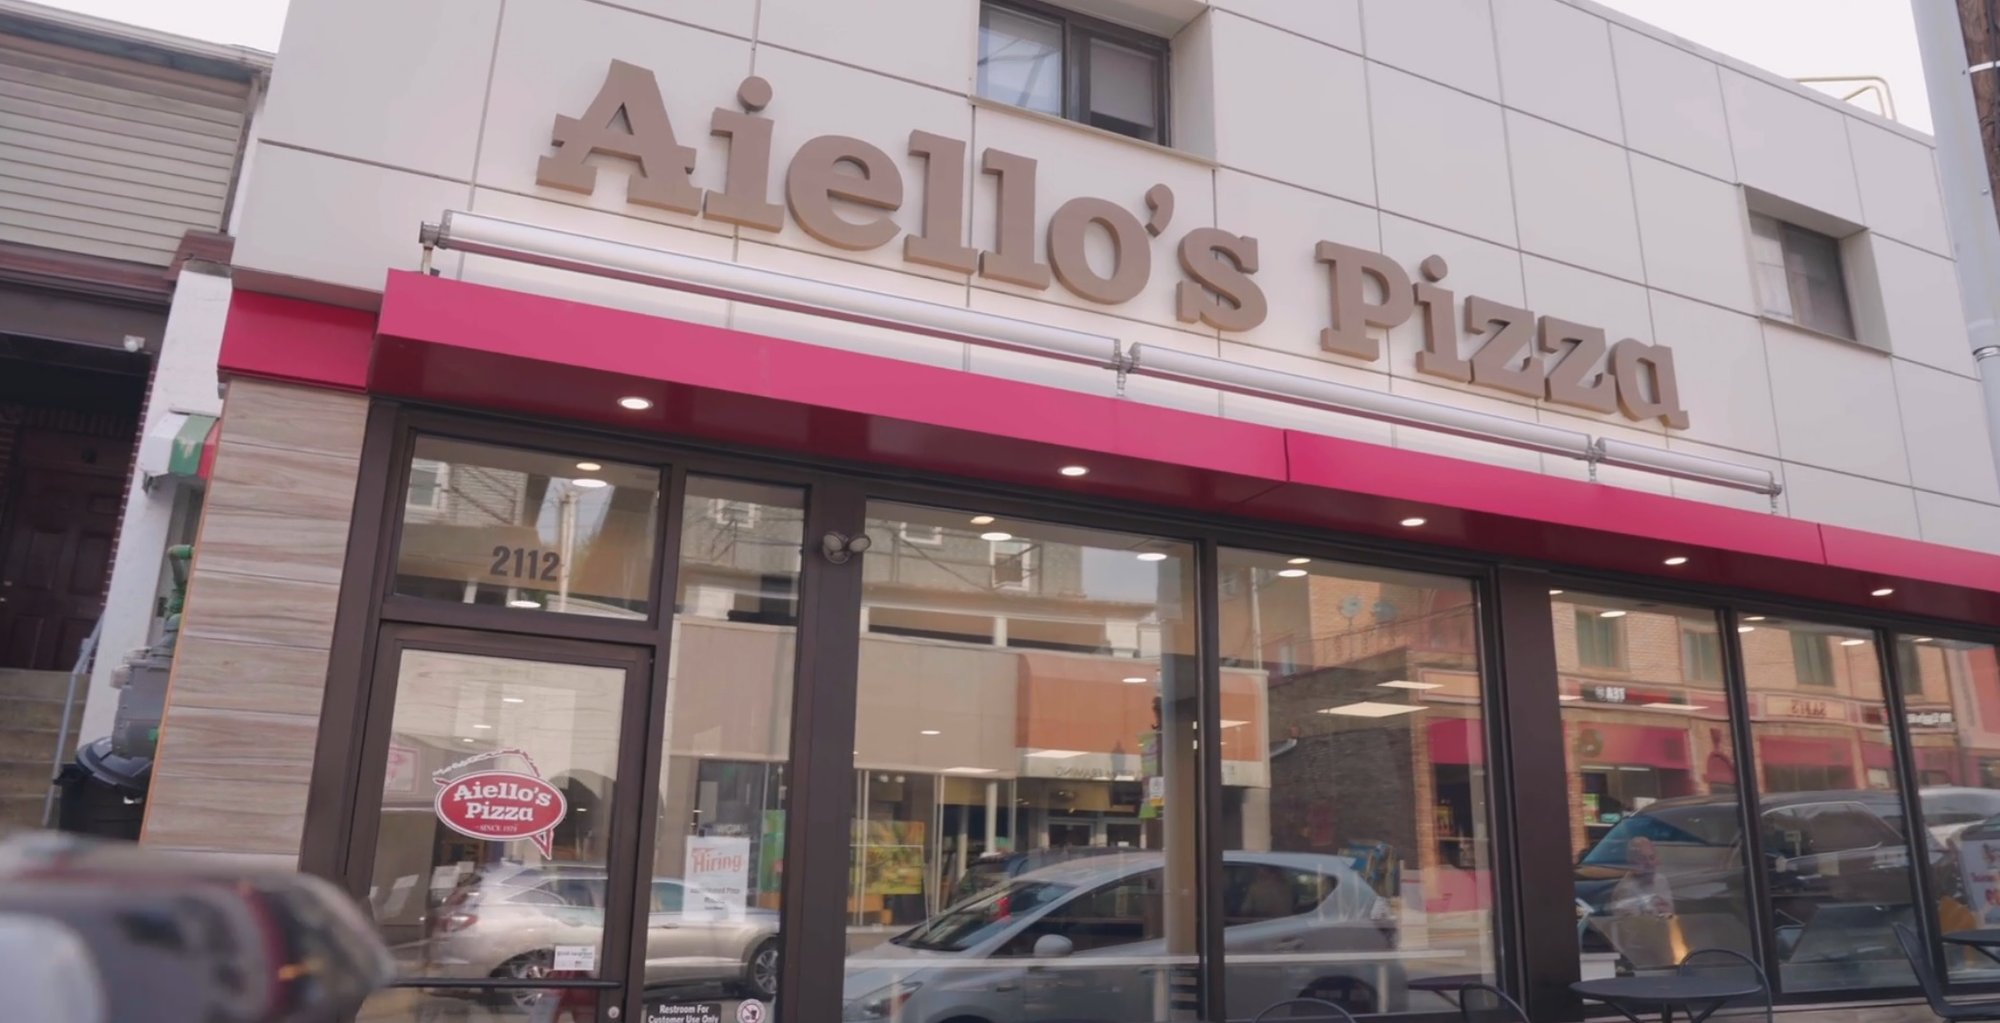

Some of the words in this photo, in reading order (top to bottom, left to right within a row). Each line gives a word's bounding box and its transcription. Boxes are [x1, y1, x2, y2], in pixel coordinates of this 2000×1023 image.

[536, 58, 1267, 333] Aiello's
[1315, 240, 1689, 430] Pizza
[490, 545, 561, 582] 2112
[453, 781, 552, 807] Aiello's
[464, 801, 534, 821] Pizza
[691, 847, 743, 873] Hiring
[648, 1015, 685, 1023] Customer
[686, 1015, 701, 1023] Use
[702, 1015, 719, 1023] Only
[659, 1004, 696, 1014] Restroom
[697, 1004, 710, 1014] For
